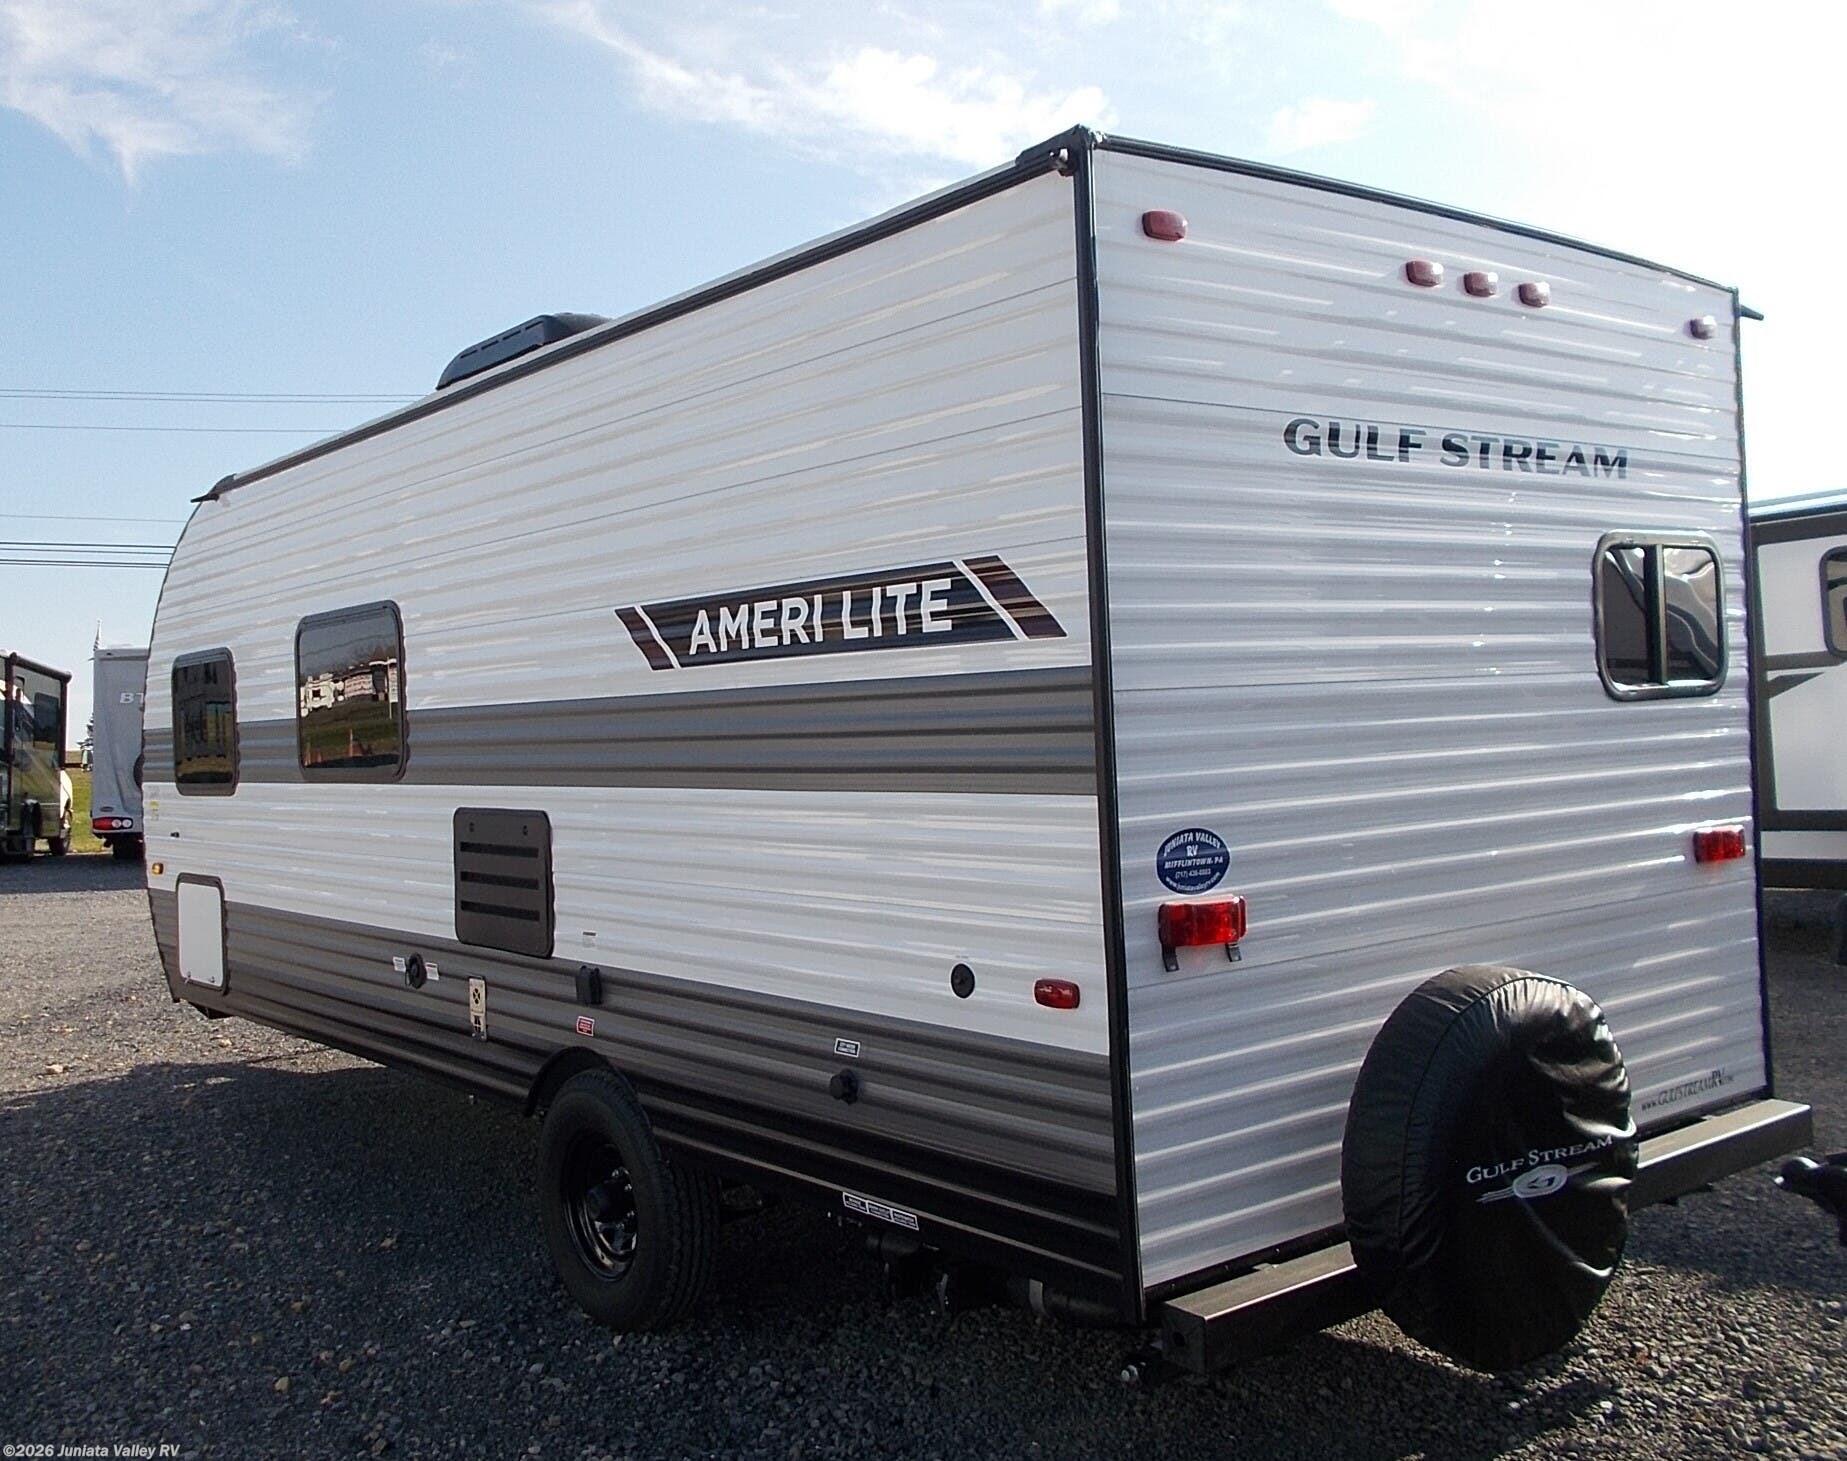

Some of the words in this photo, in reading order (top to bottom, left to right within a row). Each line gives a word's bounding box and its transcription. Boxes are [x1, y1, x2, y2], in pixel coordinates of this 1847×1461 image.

[1284, 417, 1426, 464] GULF
[1440, 432, 1629, 480] STREAM
[689, 593, 824, 655] AMERI
[842, 578, 953, 641] LITE
[1164, 832, 1194, 856] JUNIATA
[1195, 832, 1221, 849] VALLEY
[1186, 844, 1199, 857] RV
[1466, 1158, 1525, 1183] GULF
[1528, 1134, 1613, 1165] STREAM
